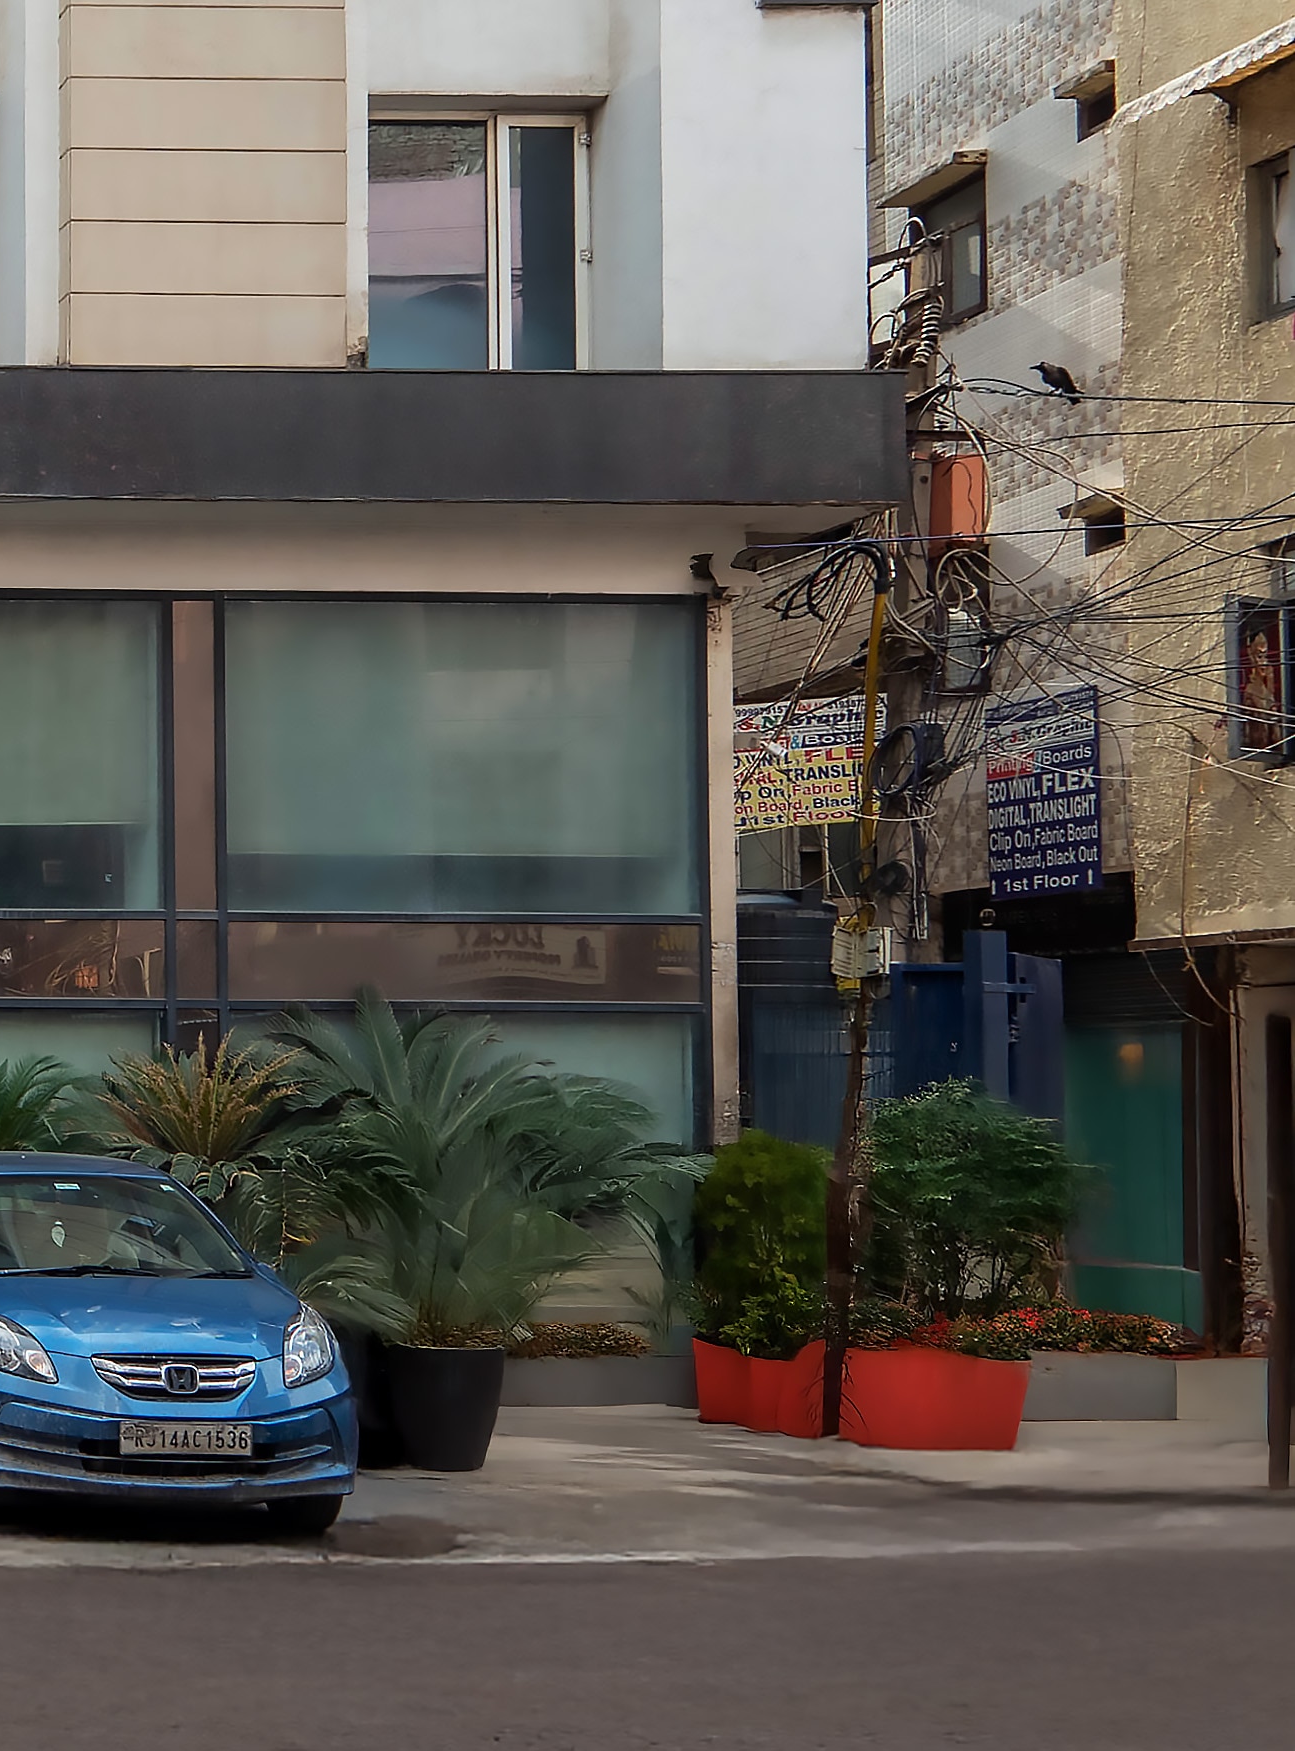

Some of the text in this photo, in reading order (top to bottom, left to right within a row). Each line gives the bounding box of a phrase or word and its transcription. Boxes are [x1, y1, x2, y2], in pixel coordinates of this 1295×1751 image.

[804, 747, 864, 764] FLE
[1042, 745, 1092, 765] Boards
[987, 782, 1007, 804] ECO
[1042, 766, 1095, 796] FLEX
[989, 831, 1012, 855] Clip
[1067, 819, 1099, 842] Board
[990, 856, 1013, 873] Neon
[1046, 846, 1077, 867] Black
[1078, 845, 1099, 863] Out
[1003, 874, 1079, 892] 1st Floor
